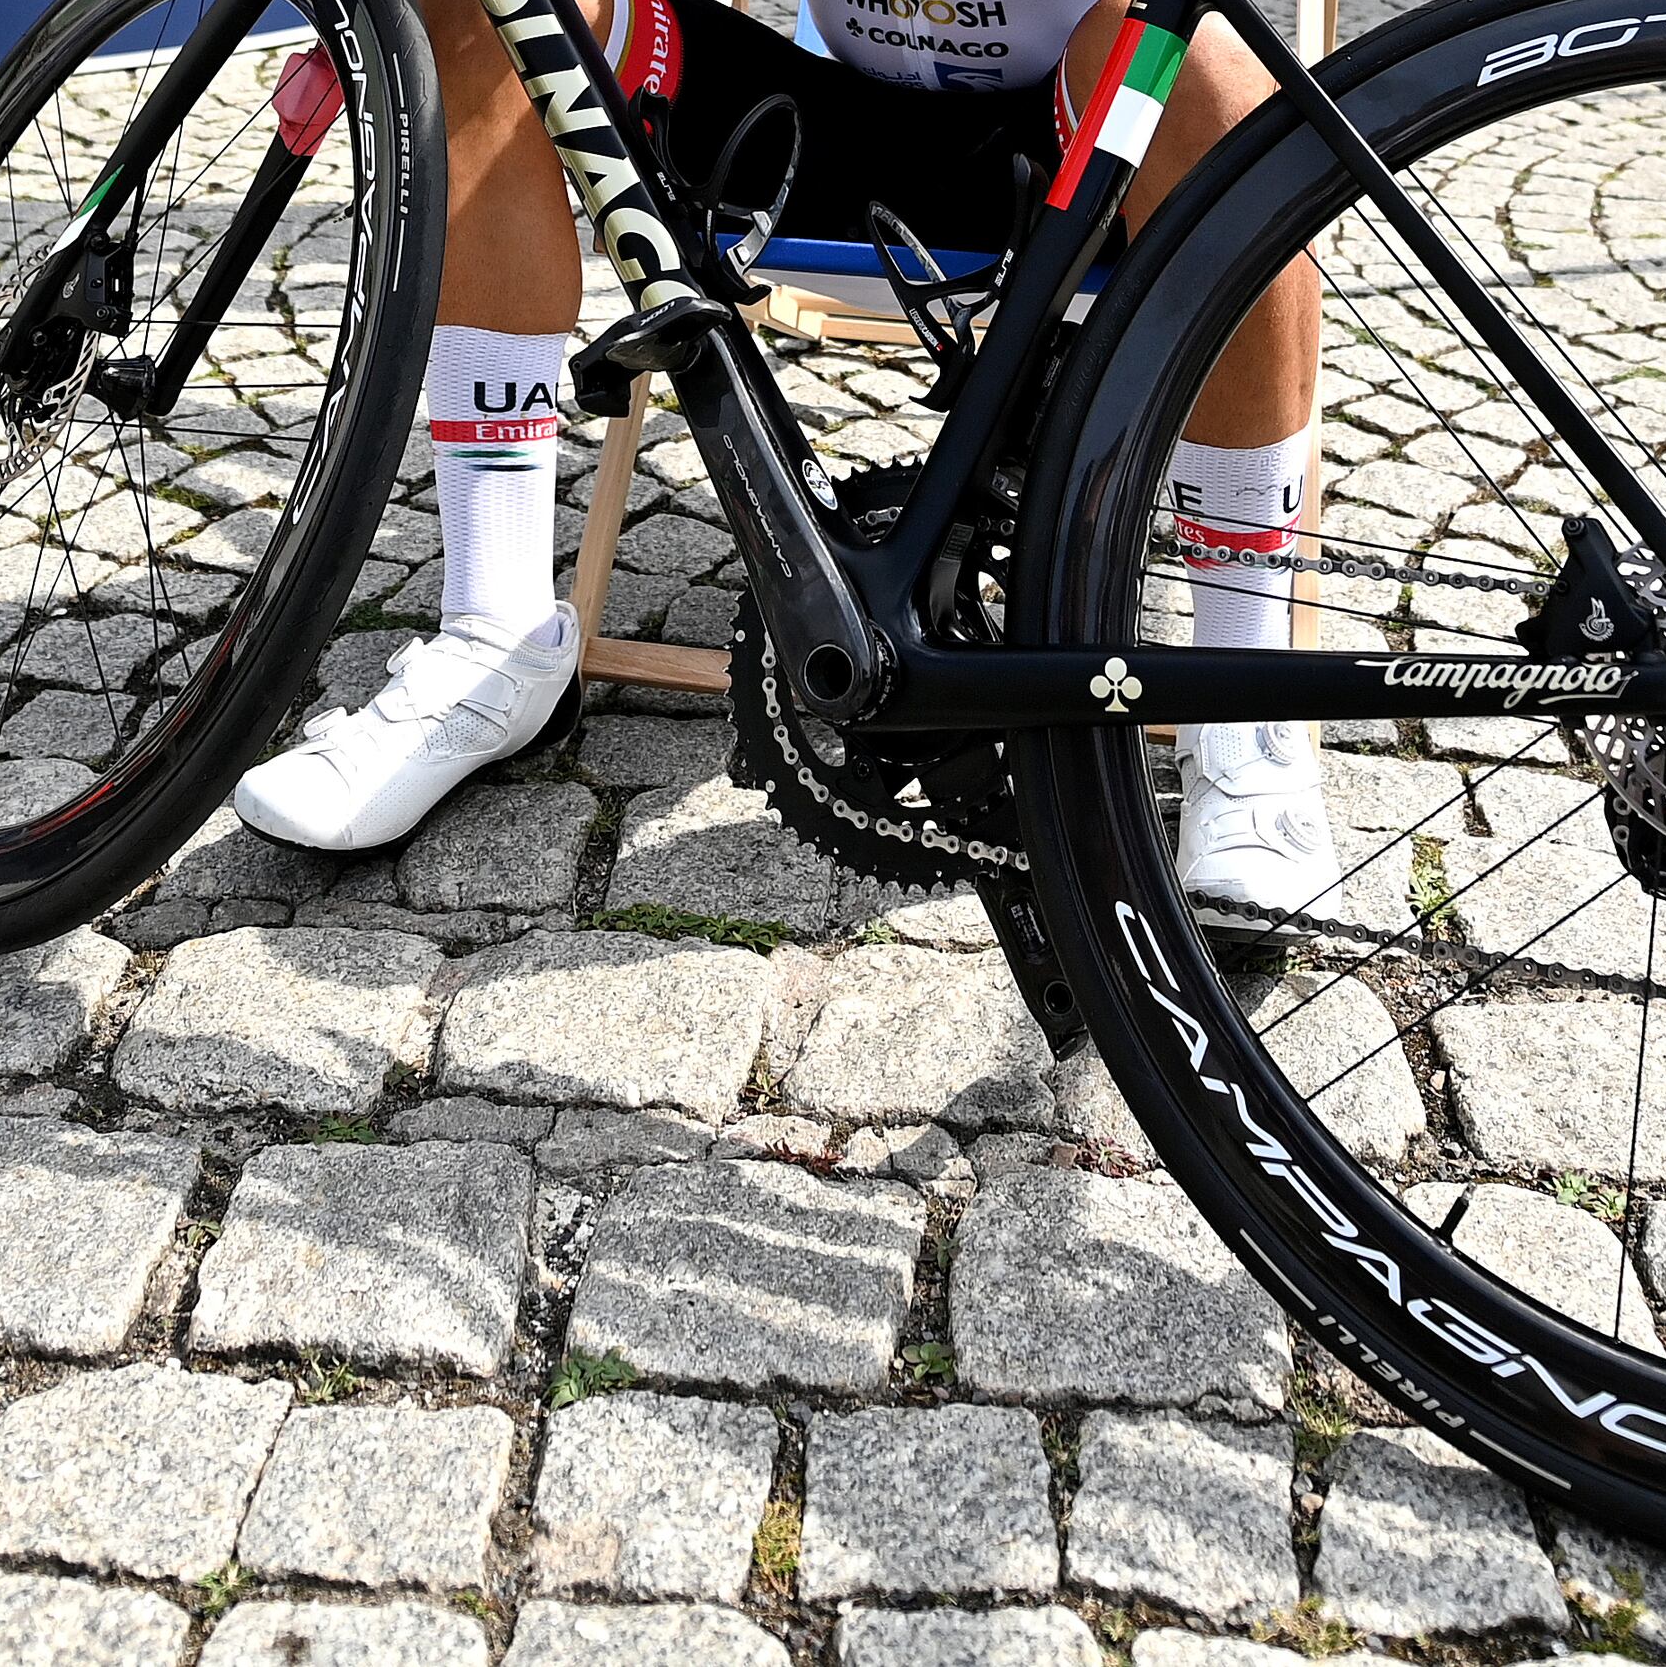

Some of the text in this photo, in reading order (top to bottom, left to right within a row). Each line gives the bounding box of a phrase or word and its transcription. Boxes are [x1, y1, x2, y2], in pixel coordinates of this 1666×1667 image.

[867, 26, 1010, 58] COLNAGO
[398, 113, 412, 214] PIRELLI
[473, 381, 559, 413] UA
[475, 422, 558, 440] Emira
[722, 434, 793, 579] CAMPAGNOLO
[1355, 655, 1640, 710] Campagnolo
[1320, 1312, 1468, 1433] PIRELLI
